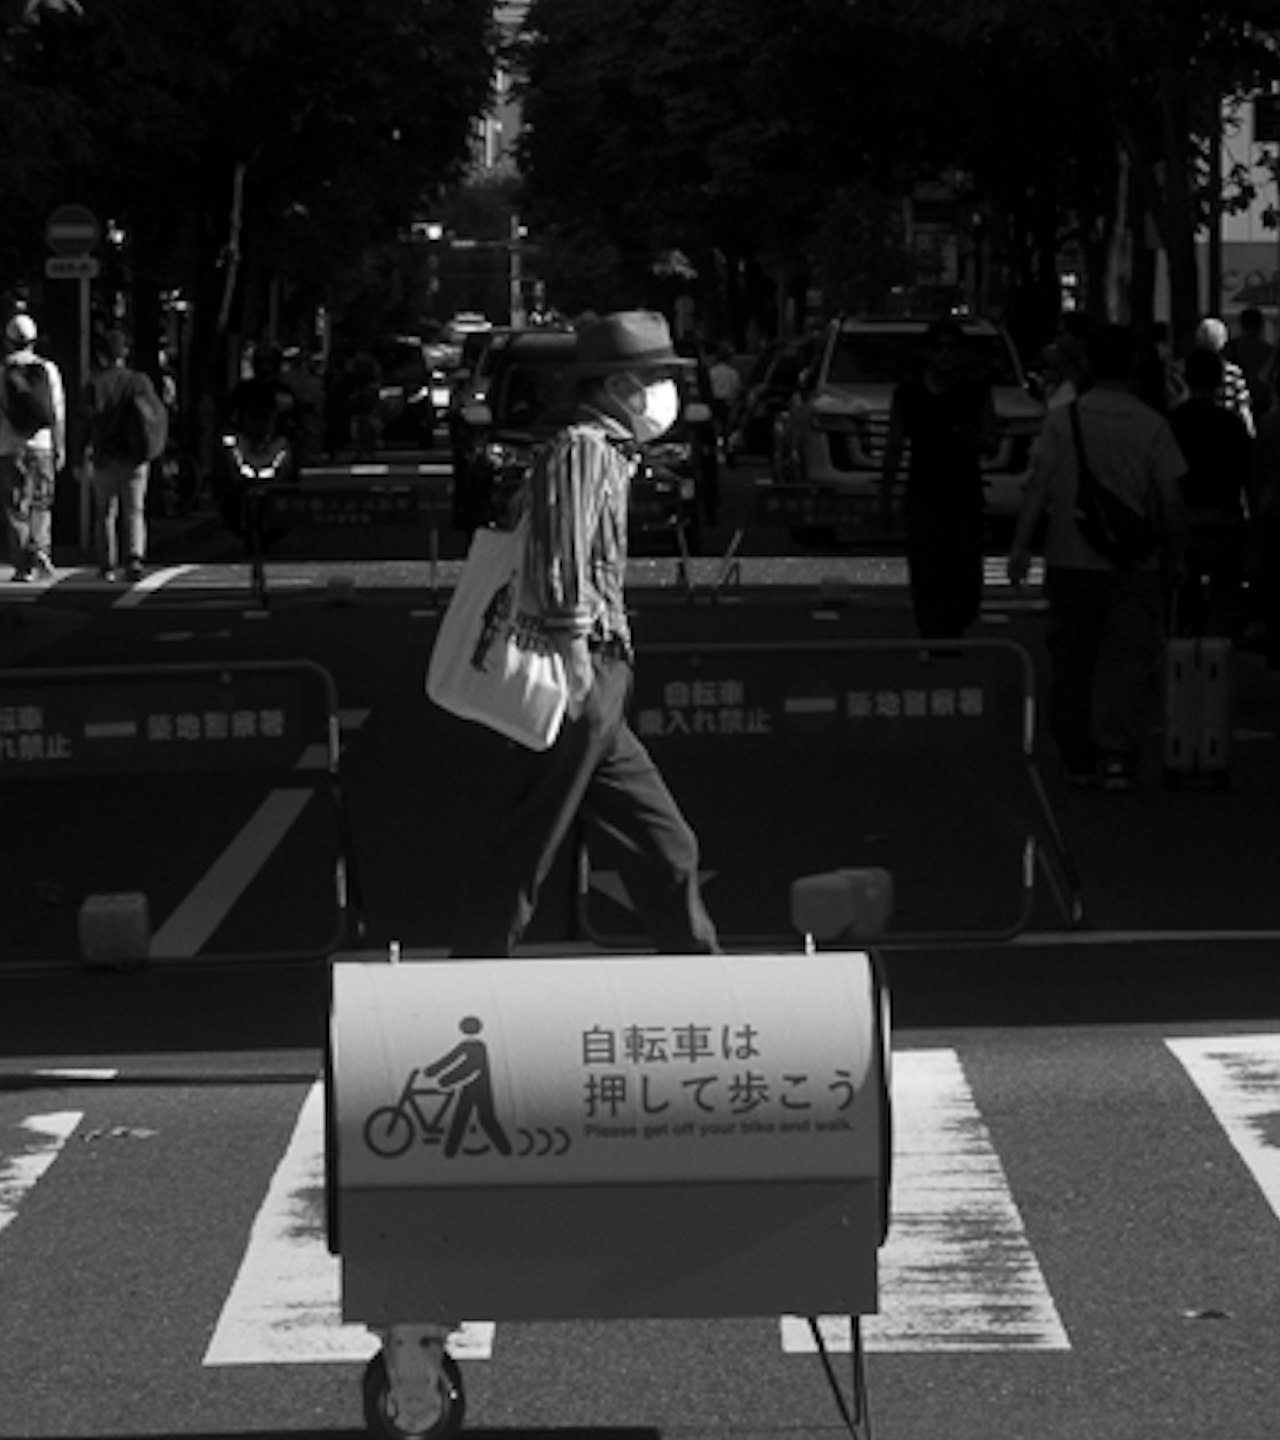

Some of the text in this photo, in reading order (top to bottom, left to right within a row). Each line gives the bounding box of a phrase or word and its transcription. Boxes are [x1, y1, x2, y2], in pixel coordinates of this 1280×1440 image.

[581, 1023, 760, 1065] 自転車は
[583, 1069, 855, 1118] 押して歩こう
[584, 1123, 637, 1138] Please
[643, 1124, 669, 1139] get
[700, 1123, 737, 1138] your
[739, 1120, 776, 1135] bike
[780, 1120, 810, 1133] and
